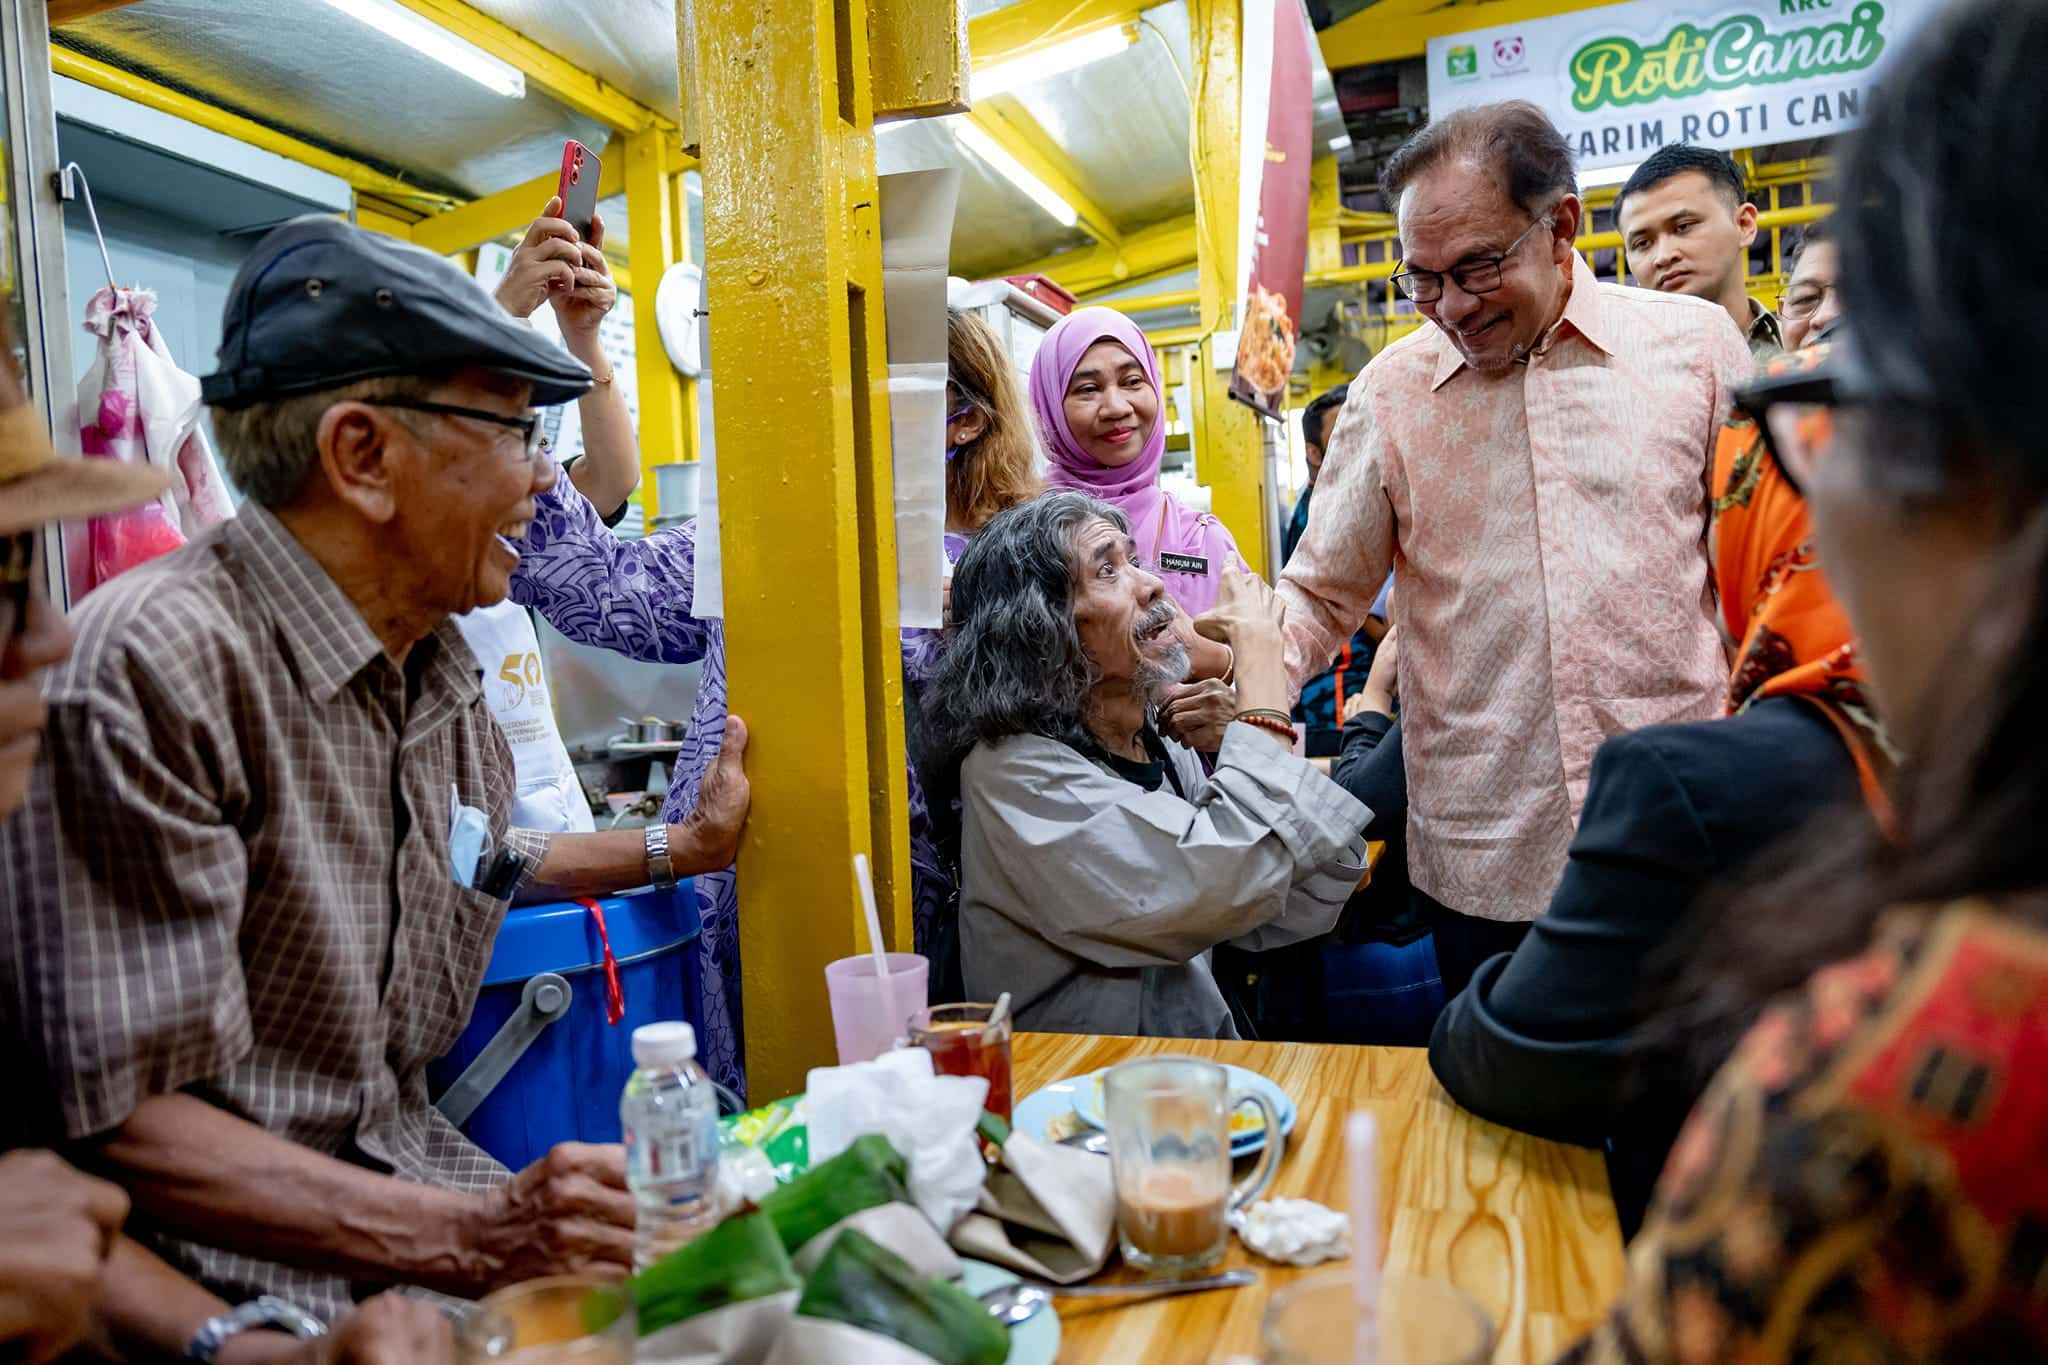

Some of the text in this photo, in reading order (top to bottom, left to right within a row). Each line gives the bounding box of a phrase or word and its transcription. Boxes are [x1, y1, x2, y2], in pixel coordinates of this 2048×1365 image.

[1566, 88, 1858, 157] ARIM ROTI CAN
[1166, 558, 1203, 569] HANUM AIN
